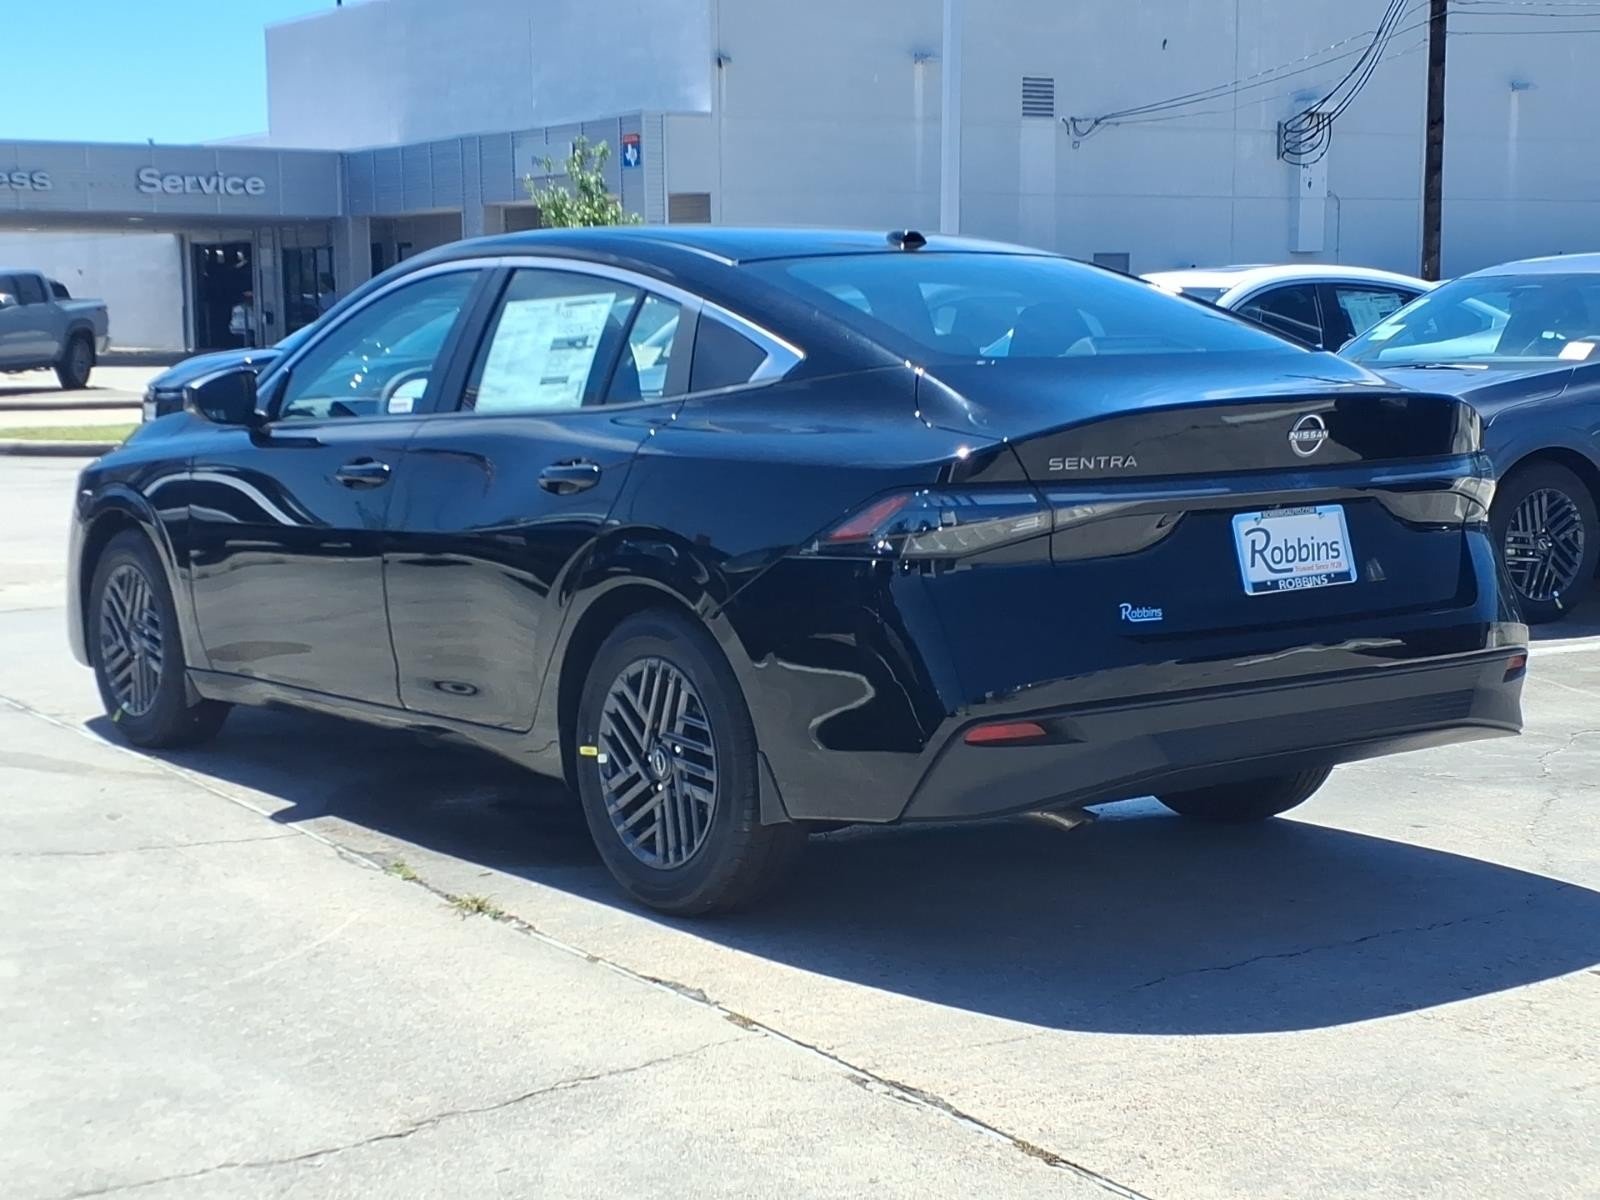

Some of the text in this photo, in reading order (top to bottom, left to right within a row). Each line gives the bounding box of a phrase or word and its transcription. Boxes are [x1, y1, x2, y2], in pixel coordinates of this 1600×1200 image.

[138, 167, 266, 195] Service
[1289, 430, 1329, 441] NISSAN
[1048, 455, 1138, 471] SENTRA
[1244, 527, 1341, 574] Robbins
[1278, 575, 1329, 590] ROBBINS
[1119, 602, 1163, 623] Robbins
